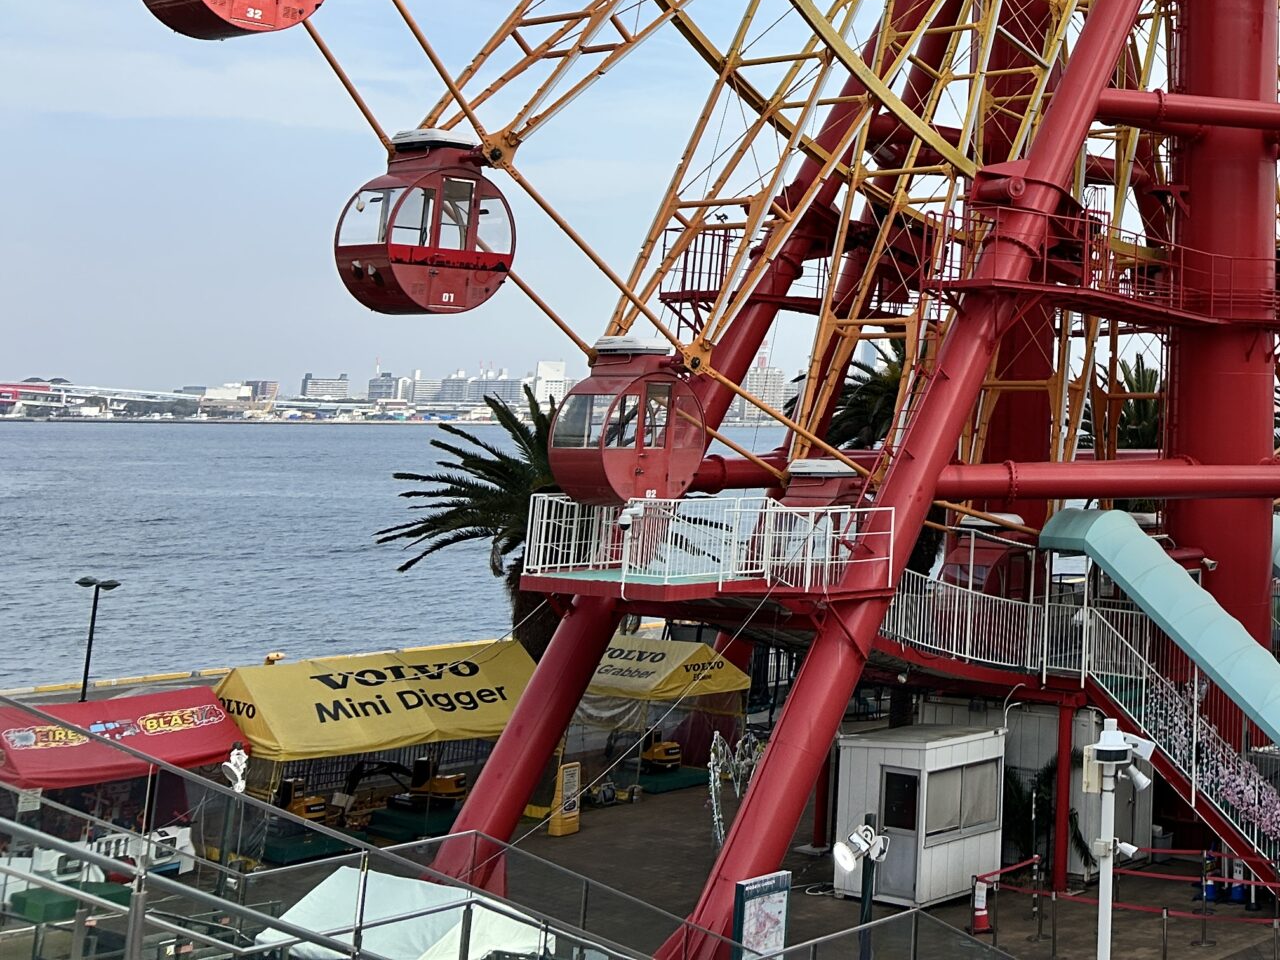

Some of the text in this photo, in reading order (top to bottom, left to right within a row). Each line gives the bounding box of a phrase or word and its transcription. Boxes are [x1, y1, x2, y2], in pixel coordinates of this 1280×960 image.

[246, 7, 262, 19] 32
[442, 292, 454, 303] 01
[645, 489, 657, 499] 02
[598, 664, 656, 679] Grabber
[684, 660, 725, 673] VOLVO
[309, 660, 480, 690] VOLVO
[218, 697, 256, 719] OLVO
[314, 685, 509, 723] Mini Digger
